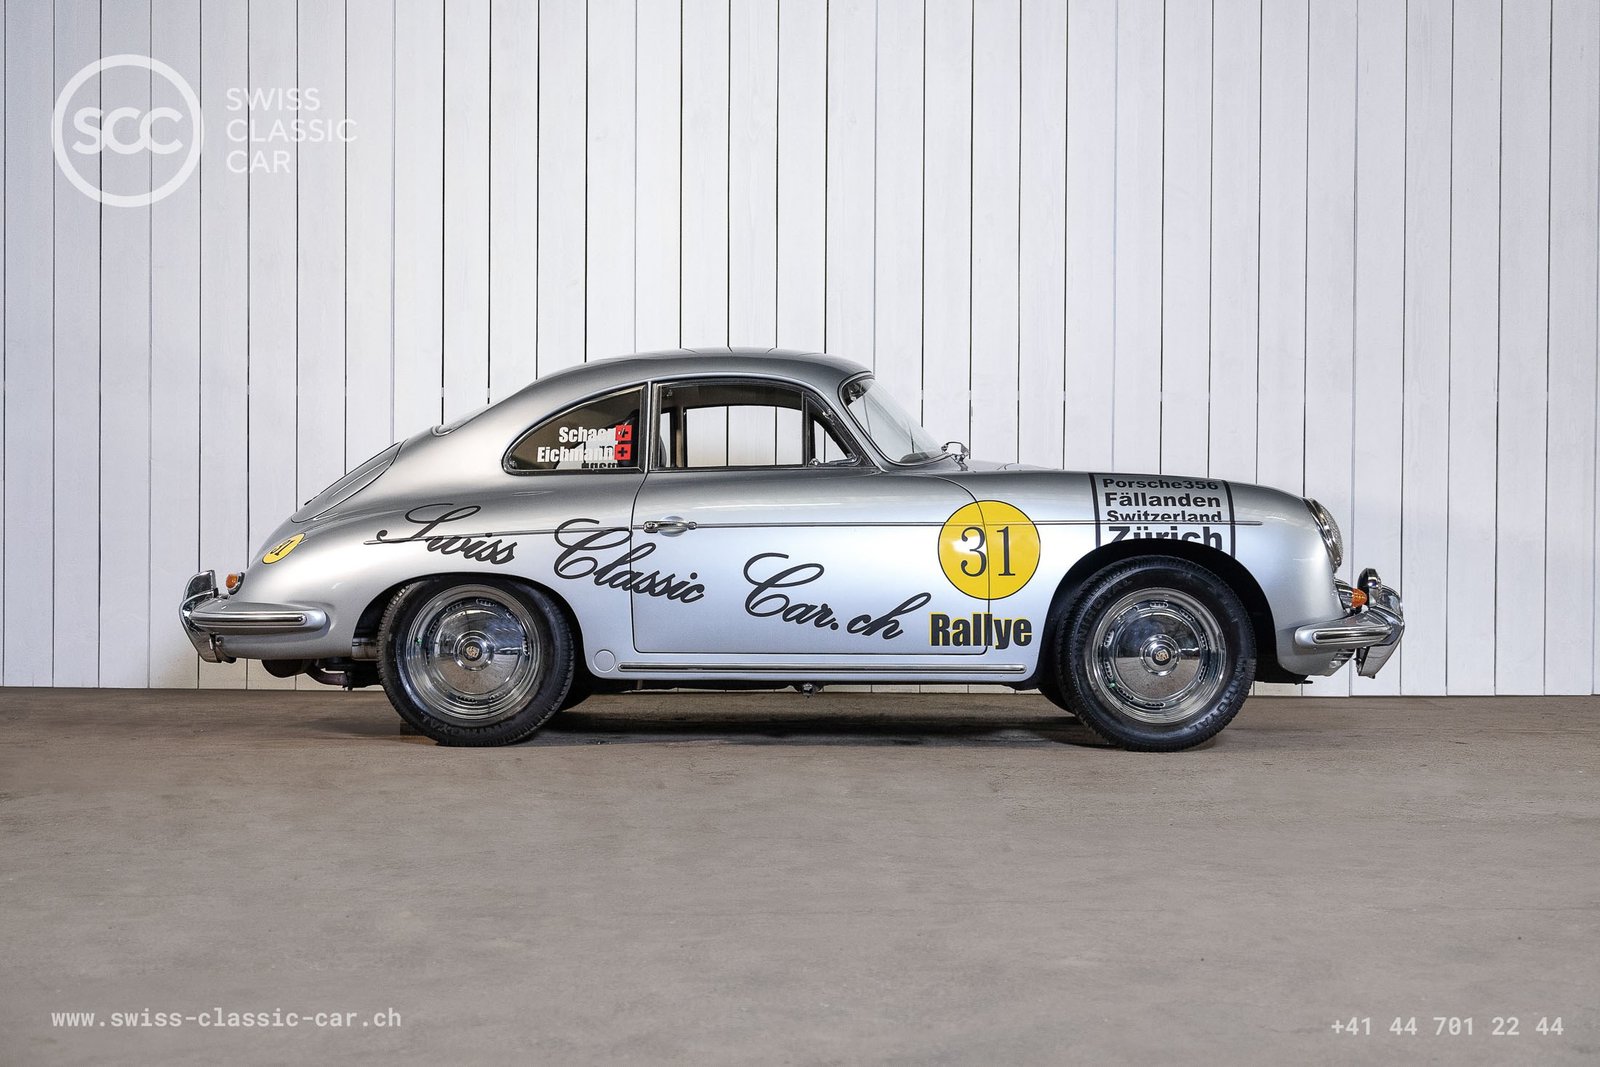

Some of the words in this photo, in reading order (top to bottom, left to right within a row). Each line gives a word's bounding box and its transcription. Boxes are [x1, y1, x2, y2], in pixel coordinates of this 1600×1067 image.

[1102, 478, 1219, 490] Porsche356
[1105, 492, 1221, 507] Fällanden
[1107, 510, 1222, 523] Switzerland
[553, 518, 706, 604] Classic
[960, 526, 1016, 577] 31
[928, 612, 1032, 649] Rallye
